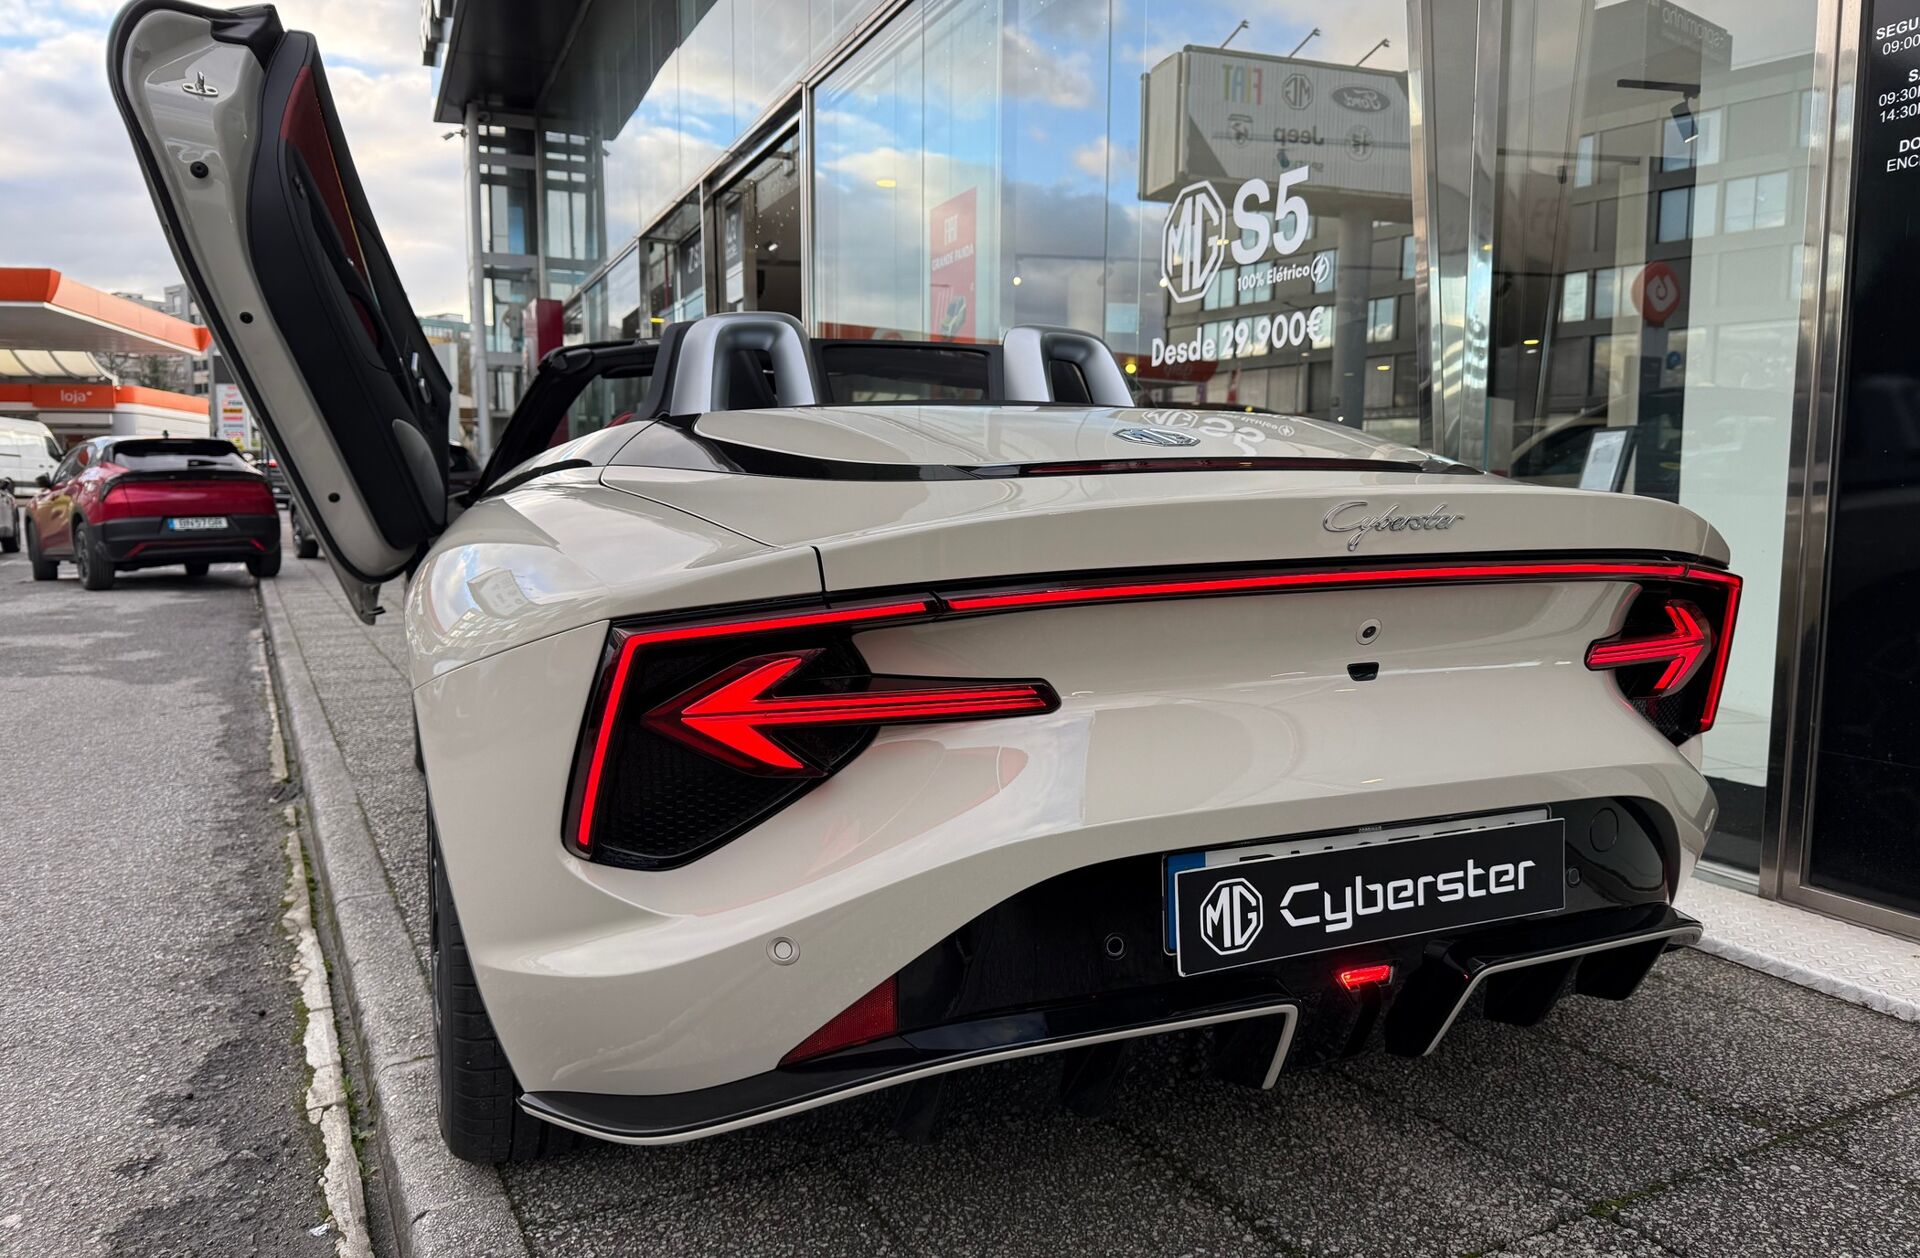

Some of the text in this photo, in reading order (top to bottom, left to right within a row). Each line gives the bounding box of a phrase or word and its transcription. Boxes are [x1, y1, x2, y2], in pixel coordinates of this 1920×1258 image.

[1876, 17, 1920, 40] SEGU
[1908, 69, 1920, 82] S
[1886, 154, 1920, 172] ENC
[1165, 165, 1310, 297] MG S5
[1237, 263, 1310, 291] 100% Elétrico
[1151, 306, 1325, 367] Desde 29.900€
[1322, 501, 1465, 551] Cyberster
[1203, 859, 1536, 953] MG Cyberster
